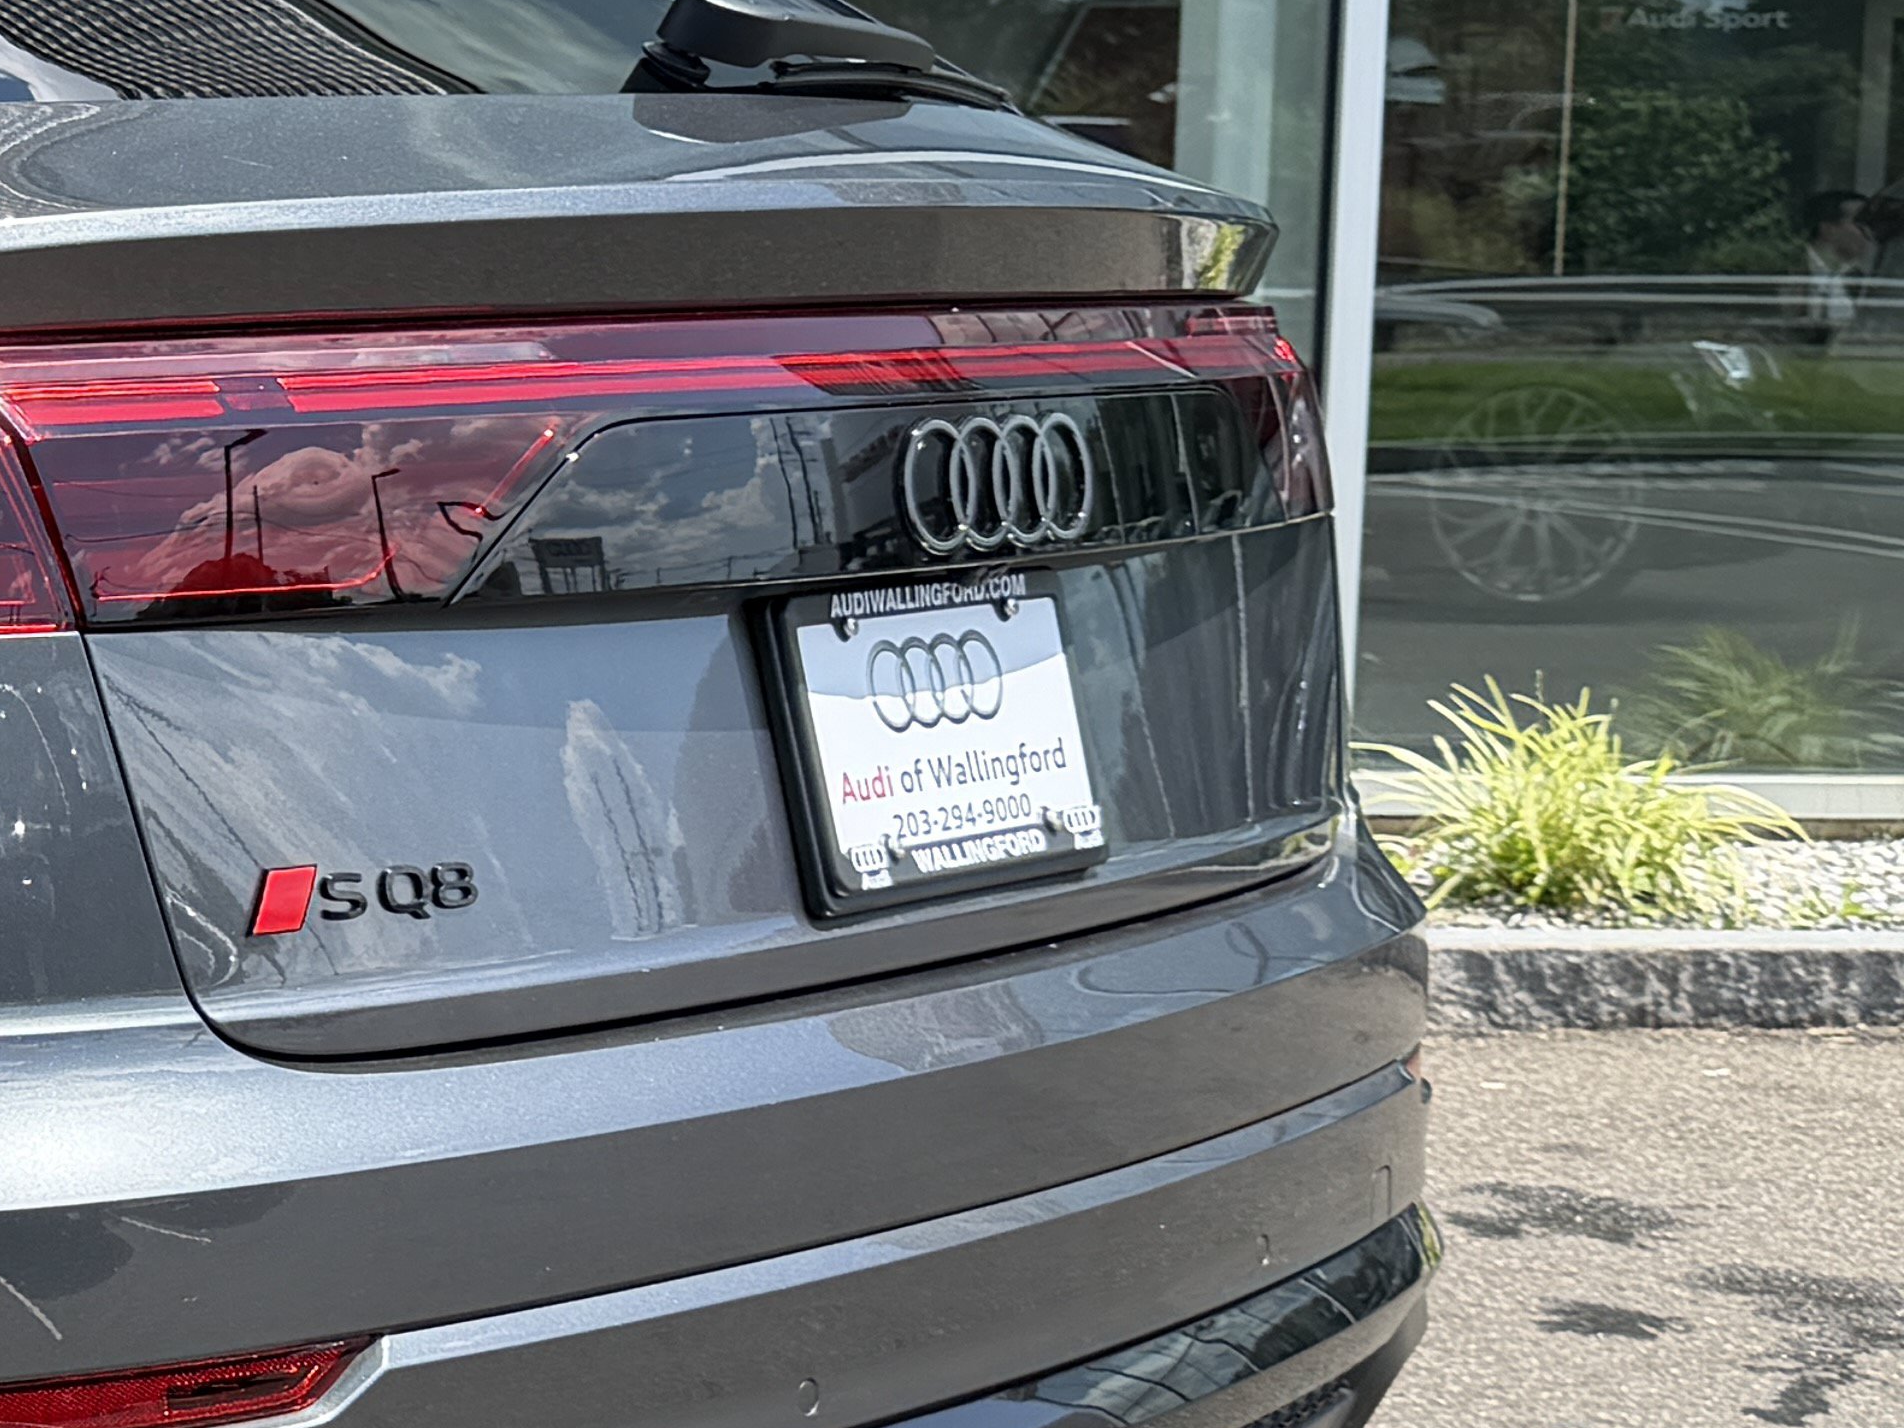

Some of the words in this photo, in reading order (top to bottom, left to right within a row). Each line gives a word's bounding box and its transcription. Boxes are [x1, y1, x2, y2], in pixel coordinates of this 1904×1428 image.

[1703, 10, 1790, 33] Sport
[830, 574, 1026, 618] AUDIWALLINGFORD.COM
[842, 765, 894, 804] Audi
[900, 758, 924, 793] of
[927, 737, 1067, 785] Wallingford
[911, 828, 1047, 873] WALLINGFORD
